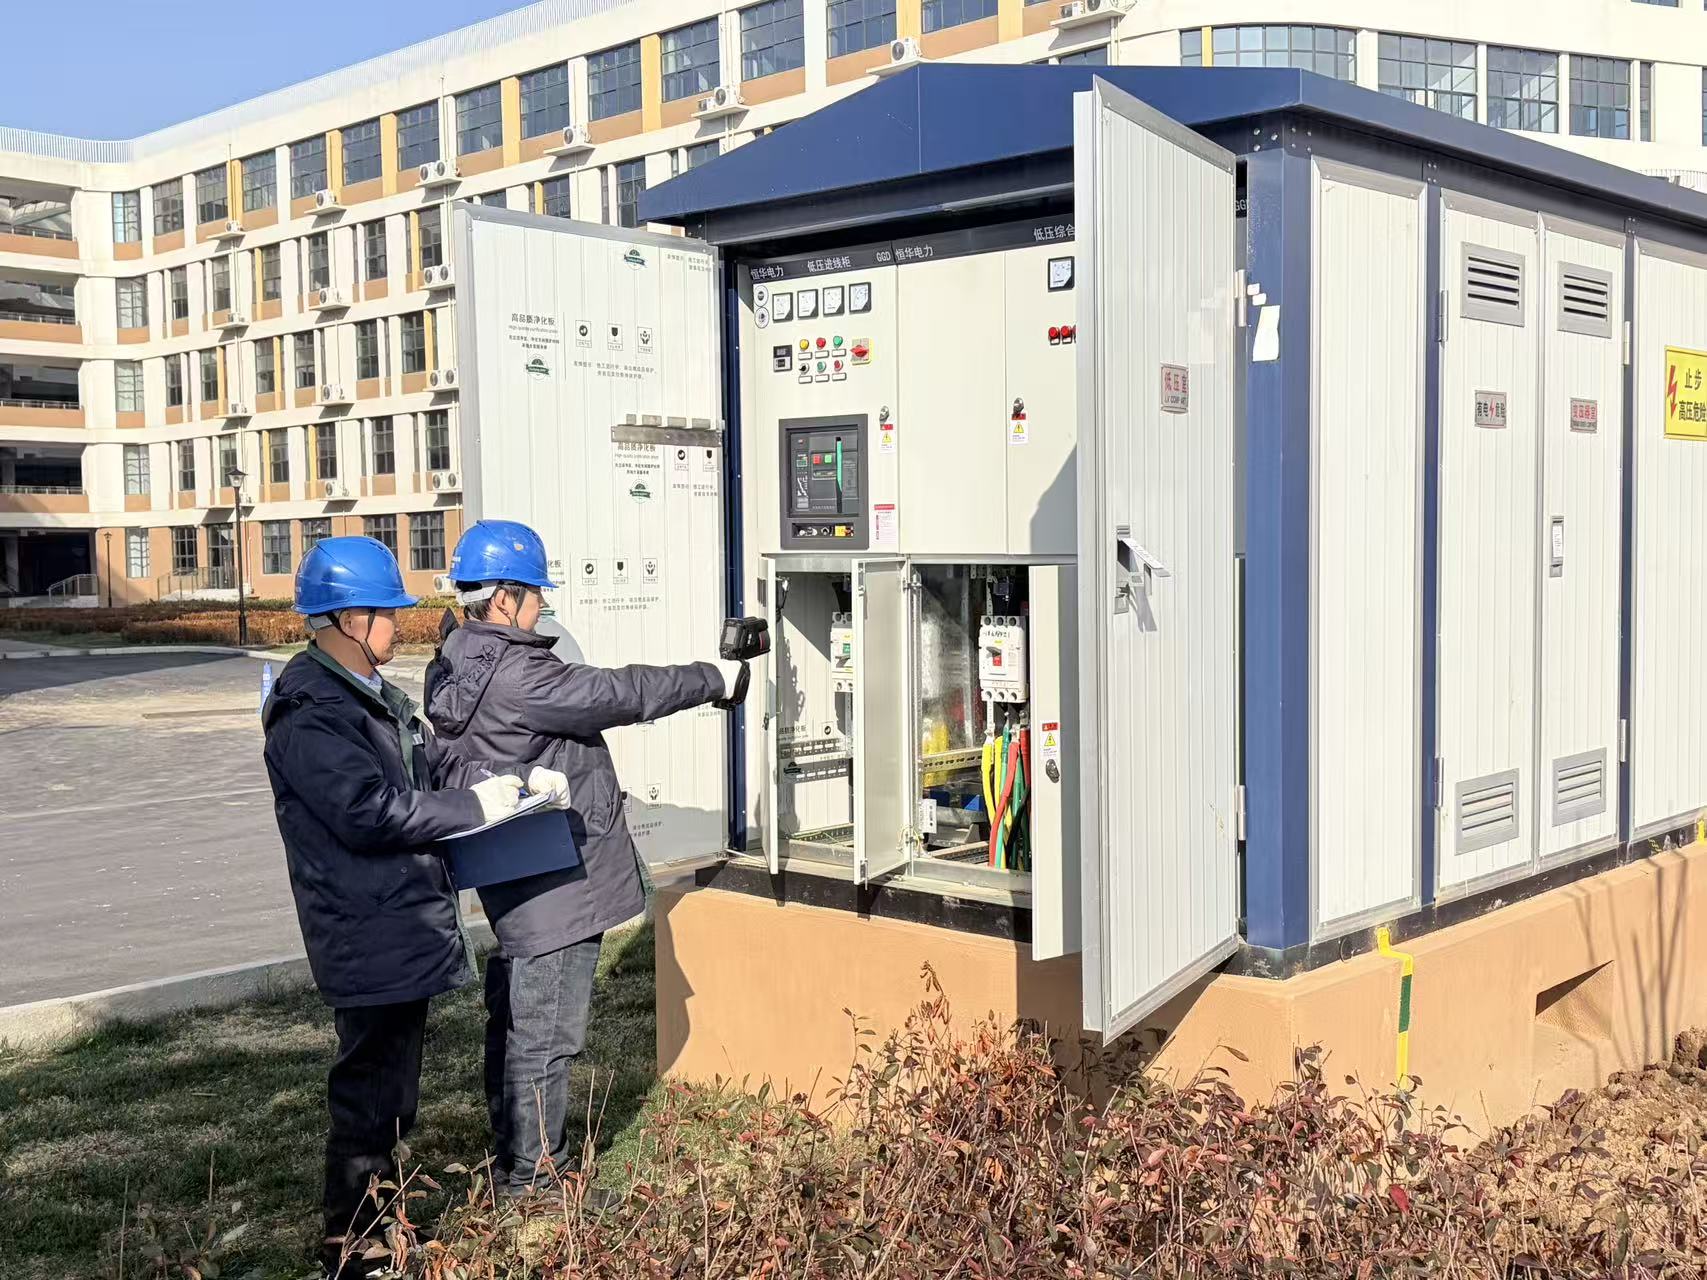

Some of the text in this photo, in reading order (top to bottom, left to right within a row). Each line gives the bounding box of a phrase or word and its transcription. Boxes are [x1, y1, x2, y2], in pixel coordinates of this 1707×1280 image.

[1033, 223, 1075, 241] 低压综合
[895, 244, 933, 261] 恒华电力
[751, 251, 891, 280] 恒华电力 低压进线柜 GGD
[511, 313, 555, 325] 高品质净化板
[1684, 368, 1702, 390] 止步
[1678, 400, 1707, 422] 高压危险
